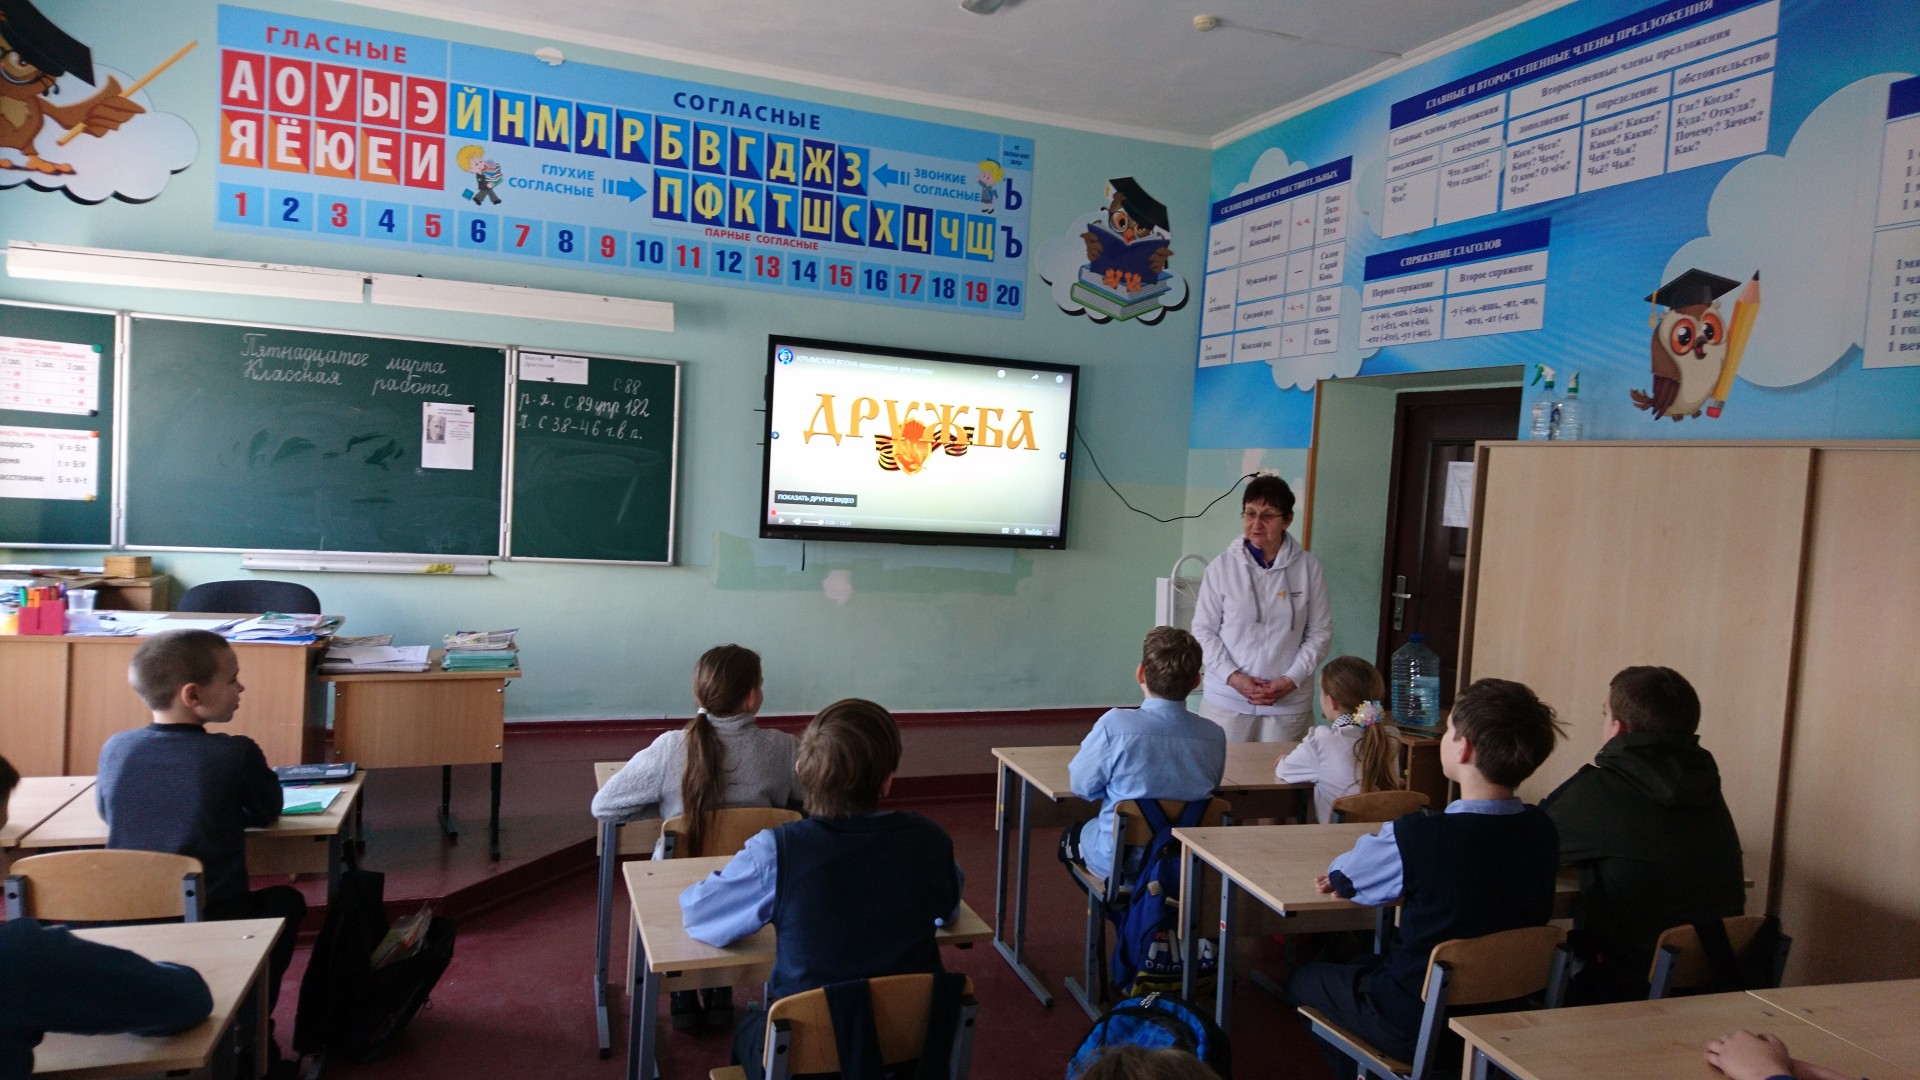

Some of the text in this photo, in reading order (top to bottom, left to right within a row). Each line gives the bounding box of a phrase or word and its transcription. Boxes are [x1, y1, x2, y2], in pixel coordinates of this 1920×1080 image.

[266, 26, 408, 64] ГЛАСНЫЕ
[1425, 1, 1714, 110] ГЛАВНЫЕ И ВТОРОСТЕПЕННЫЕ ЧЛЕНЫ ПРЕДЛОЖЕНИЯ
[1541, 29, 1731, 97] Второстепенные члены предложения
[1678, 52, 1771, 86] обстоятельство
[229, 60, 439, 126] А О У Ы Э
[1596, 86, 1659, 110] определение
[1677, 88, 1741, 114] Где? Когда?
[673, 92, 821, 131] СОГЛАСНЫЕ
[1675, 111, 1764, 142] Почему? Зачем?
[1676, 98, 1756, 128] Куда? Откуда?
[228, 118, 438, 182] Я Ё Ю Е И
[458, 86, 862, 187] Й Н М Л Р Б В Г Д Ж З
[1674, 140, 1701, 155] Как?
[508, 178, 595, 198] СОГЛАСНЫЕ
[541, 163, 595, 181] ГЛУХИЕ
[914, 167, 967, 185] ЗВОНКИЕ
[913, 183, 981, 202] СОГЛАСНЫЕ
[659, 177, 995, 262] П Ф К Т Ш С Х Ц Ч Щ
[235, 192, 1020, 306] 1 2 3 4 5 6 7 8 9 10 11 12 13 14 15 16 17 18 19 20
[704, 227, 820, 251] ПАРНЫЕ СОГЛАСНЫЕ
[1001, 225, 1023, 258] Ъ
[1400, 238, 1502, 267] СПРЯЖЕНИЕ ГЛАГОЛОВ
[1459, 263, 1534, 283] Второе спряжение
[240, 333, 447, 377] Пятнадцатое марта
[243, 358, 452, 397] Классная работа
[624, 398, 650, 417] 182
[803, 393, 1040, 450] ДРУЖБА
[777, 494, 809, 502] ПОКАЗАТЬ
[810, 495, 834, 503] ДРУГИЕ
